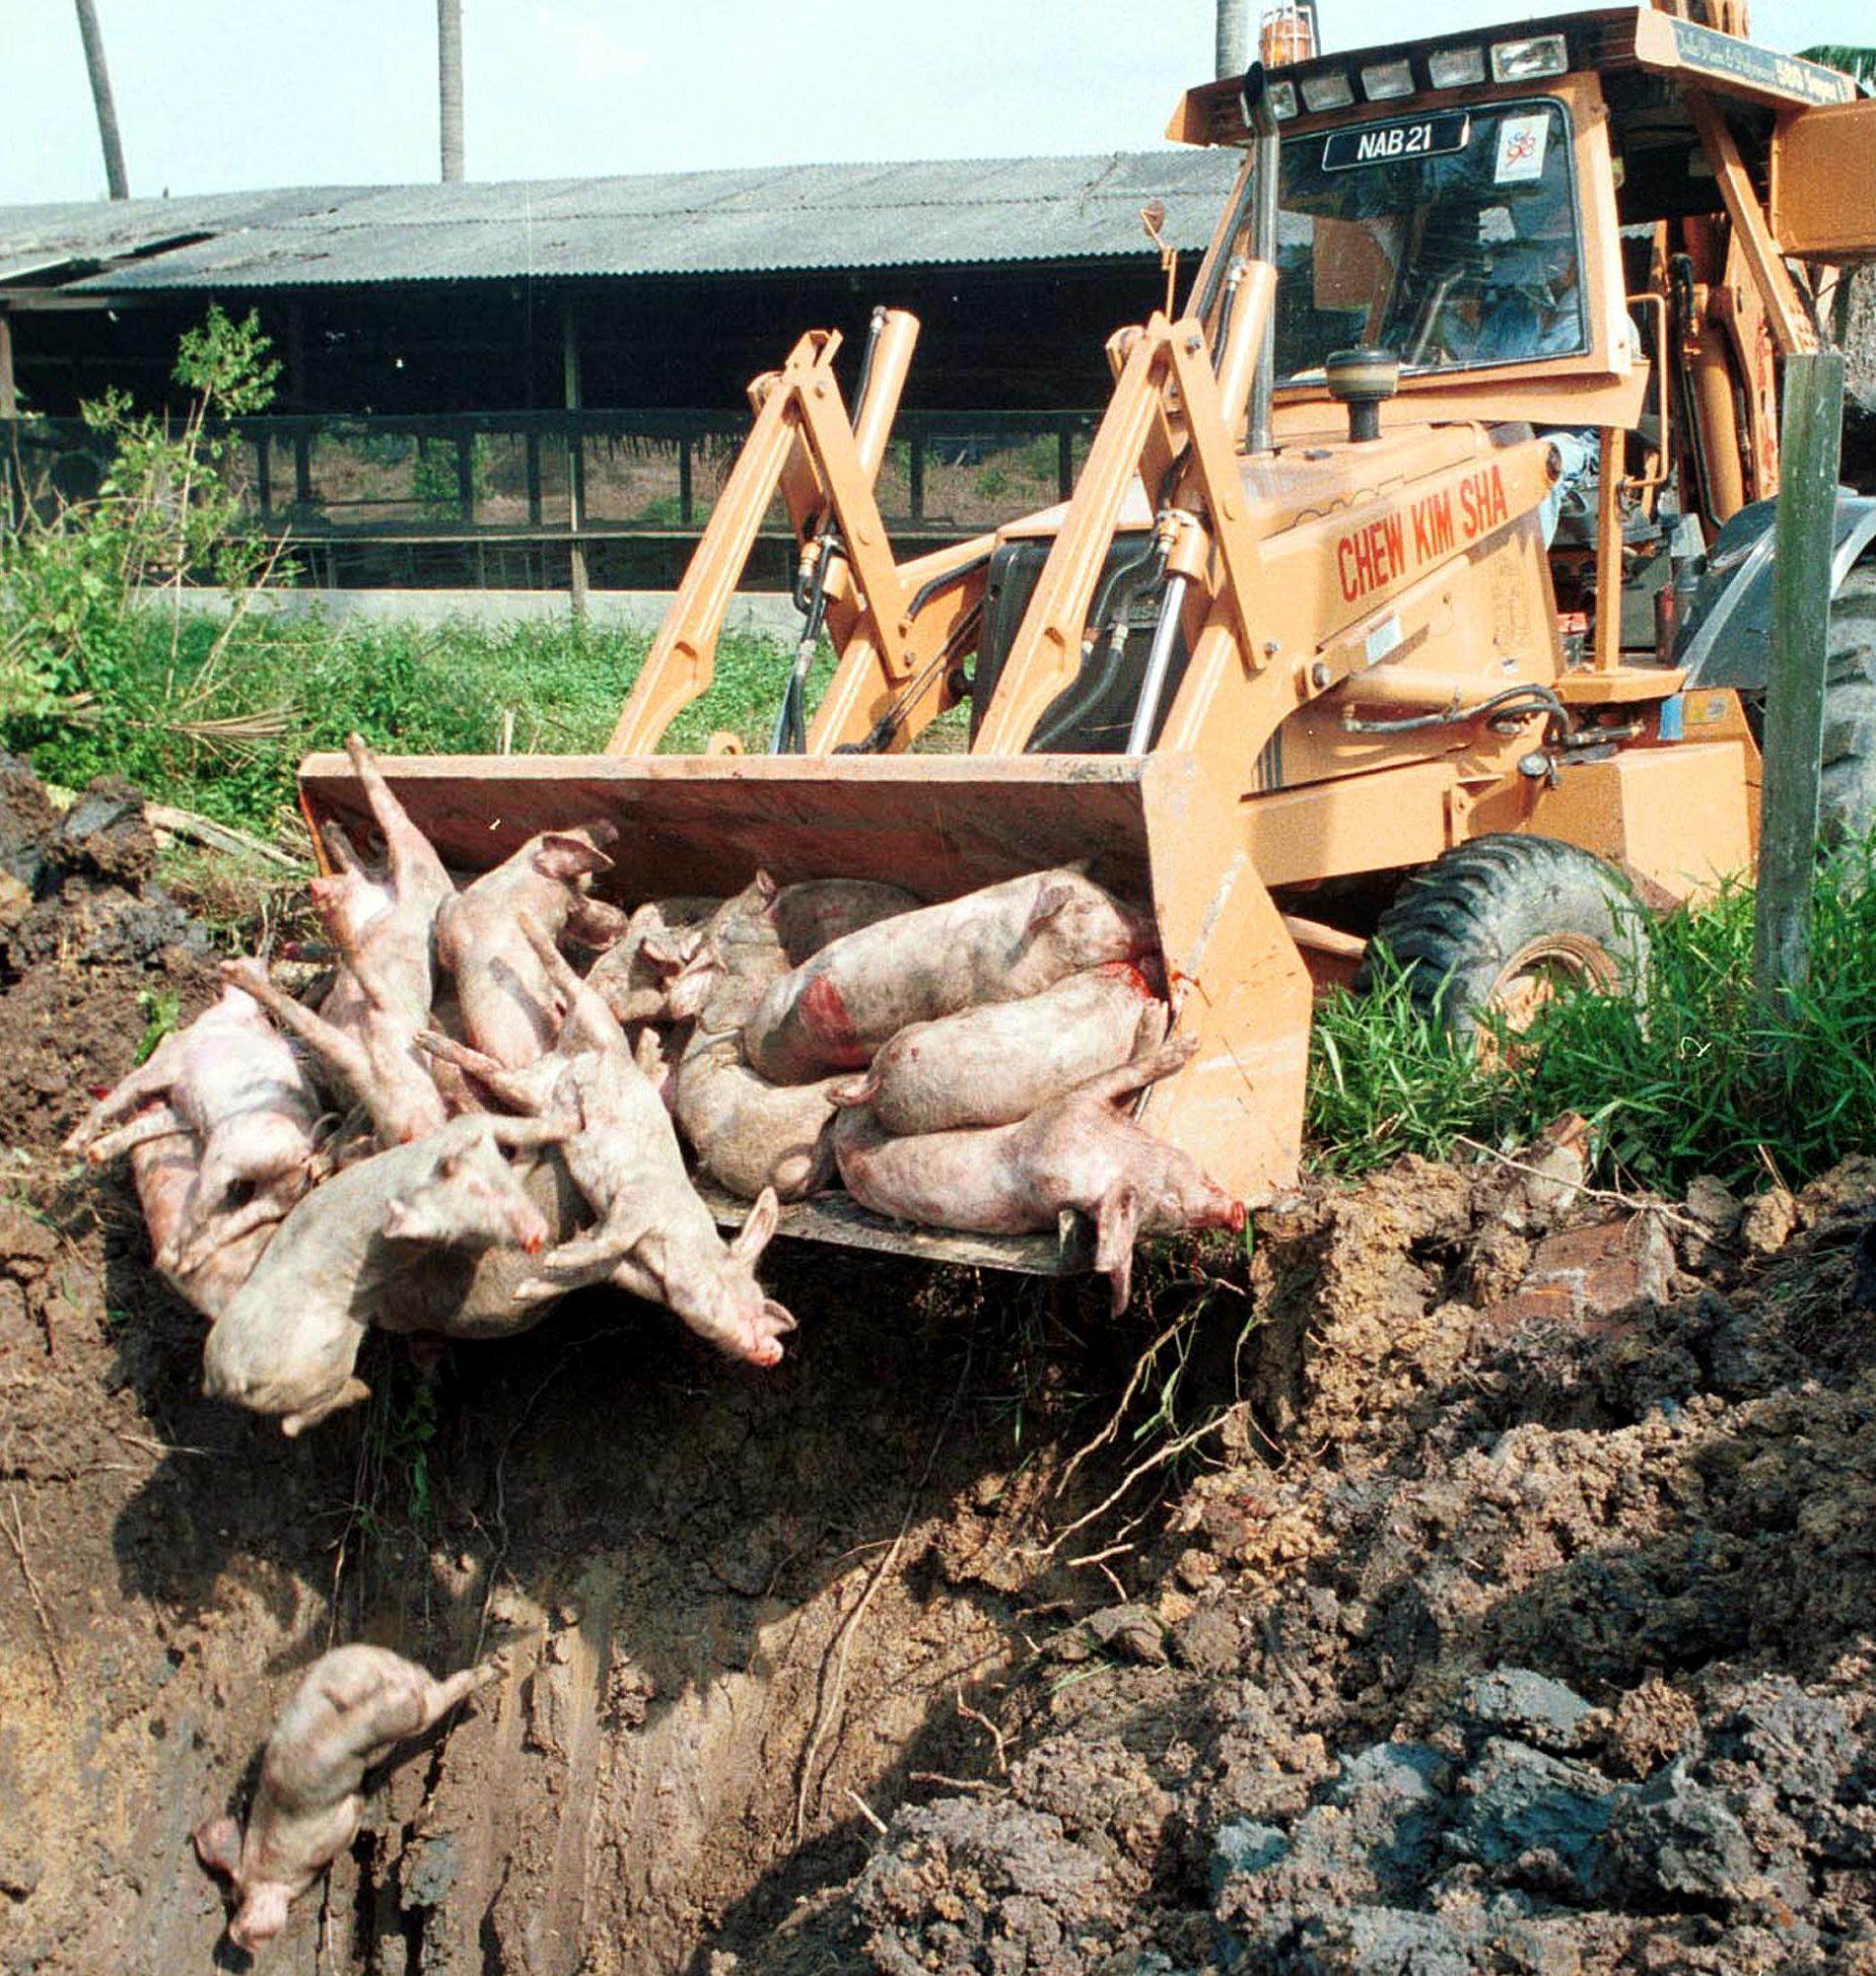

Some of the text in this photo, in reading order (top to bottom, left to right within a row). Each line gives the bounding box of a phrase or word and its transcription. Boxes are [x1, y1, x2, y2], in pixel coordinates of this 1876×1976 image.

[1356, 124, 1431, 161] NAB 21
[1338, 464, 1508, 602] CHEW KIM SHA
